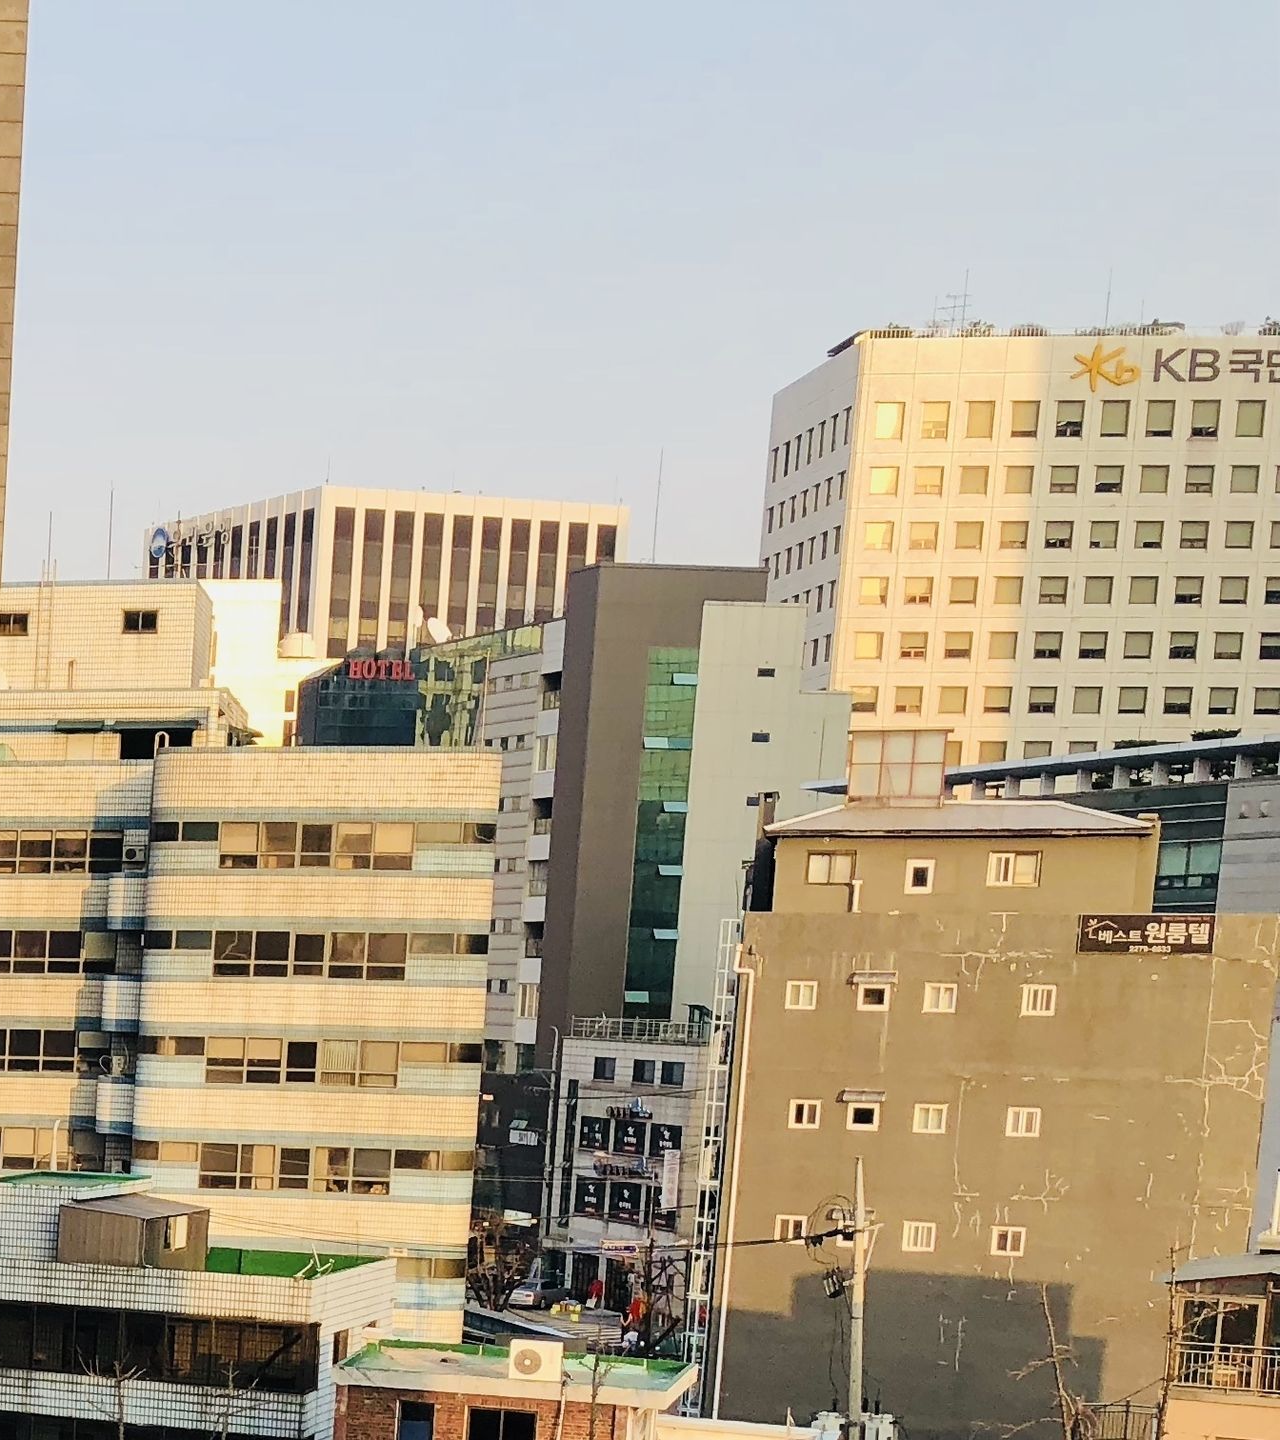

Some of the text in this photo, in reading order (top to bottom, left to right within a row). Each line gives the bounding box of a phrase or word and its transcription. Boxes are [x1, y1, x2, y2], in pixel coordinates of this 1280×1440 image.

[1153, 348, 1221, 383] KB
[348, 658, 415, 681] HOTEL
[1097, 922, 1210, 944] 베스트 원룸텔
